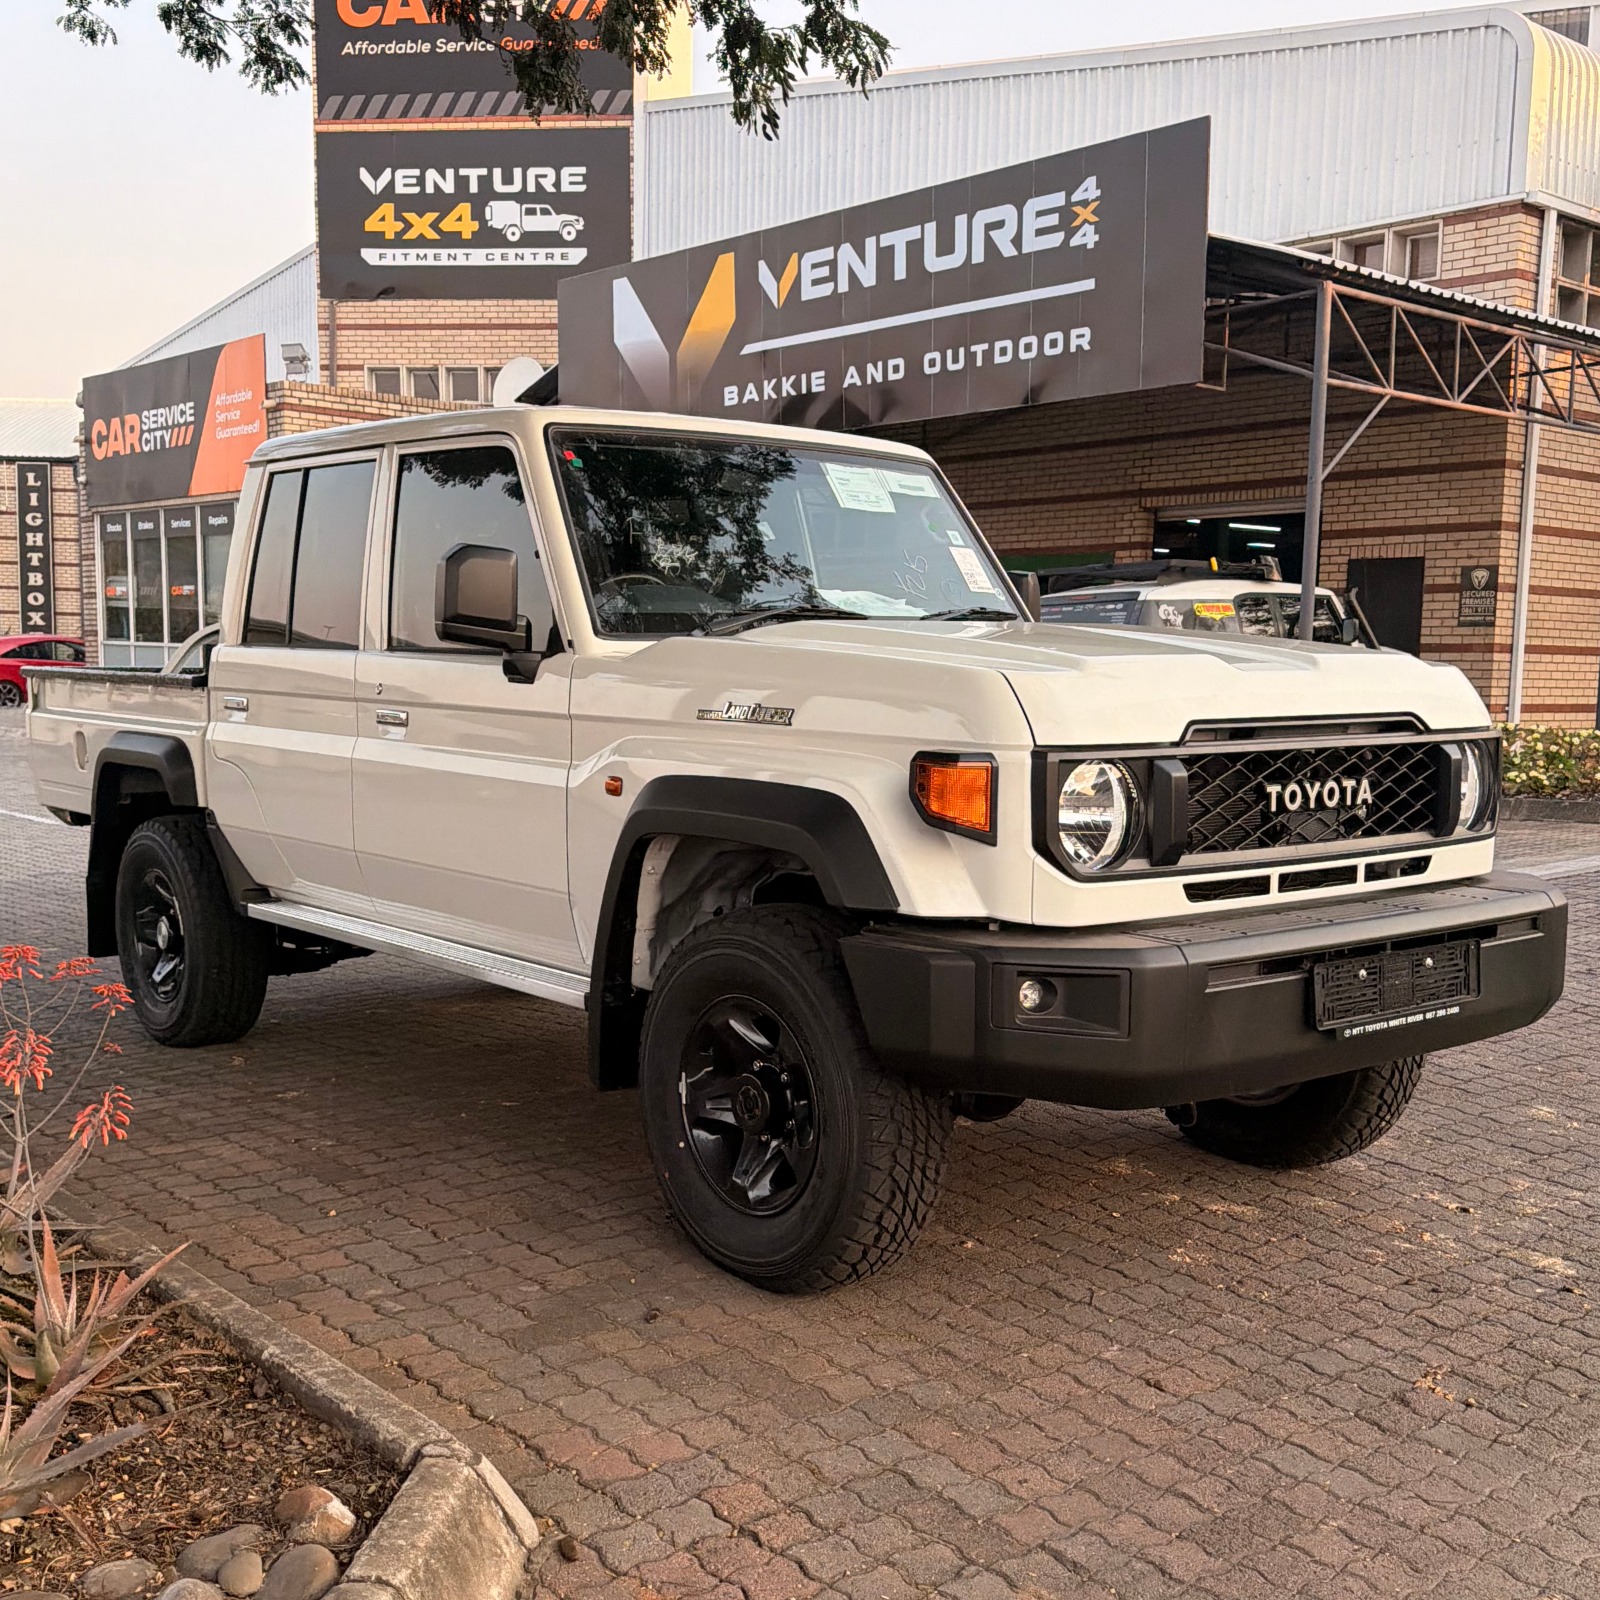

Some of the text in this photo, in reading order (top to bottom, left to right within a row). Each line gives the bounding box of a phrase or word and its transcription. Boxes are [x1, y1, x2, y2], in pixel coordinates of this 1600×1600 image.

[341, 40, 431, 55] Affordable
[436, 38, 495, 53] Service
[360, 167, 587, 195] VENTURE
[364, 203, 479, 240] 4x4
[379, 252, 570, 261] FITMENT CENTRE
[758, 191, 1066, 309] VENTURE
[724, 327, 1092, 406] BAKKIE AND OUTDOOR
[215, 390, 253, 407] Affordable
[215, 409, 241, 422] Service
[91, 402, 195, 460] CAR SERVICE
[141, 429, 172, 452] CITY
[215, 420, 260, 440] Guaranteed!
[170, 518, 191, 529] Services
[1266, 779, 1373, 812] TOYOTA
[1365, 1022, 1388, 1032] TOYOTA
[1388, 1017, 1407, 1028] WHITE
[1407, 1013, 1424, 1024] RIVER
